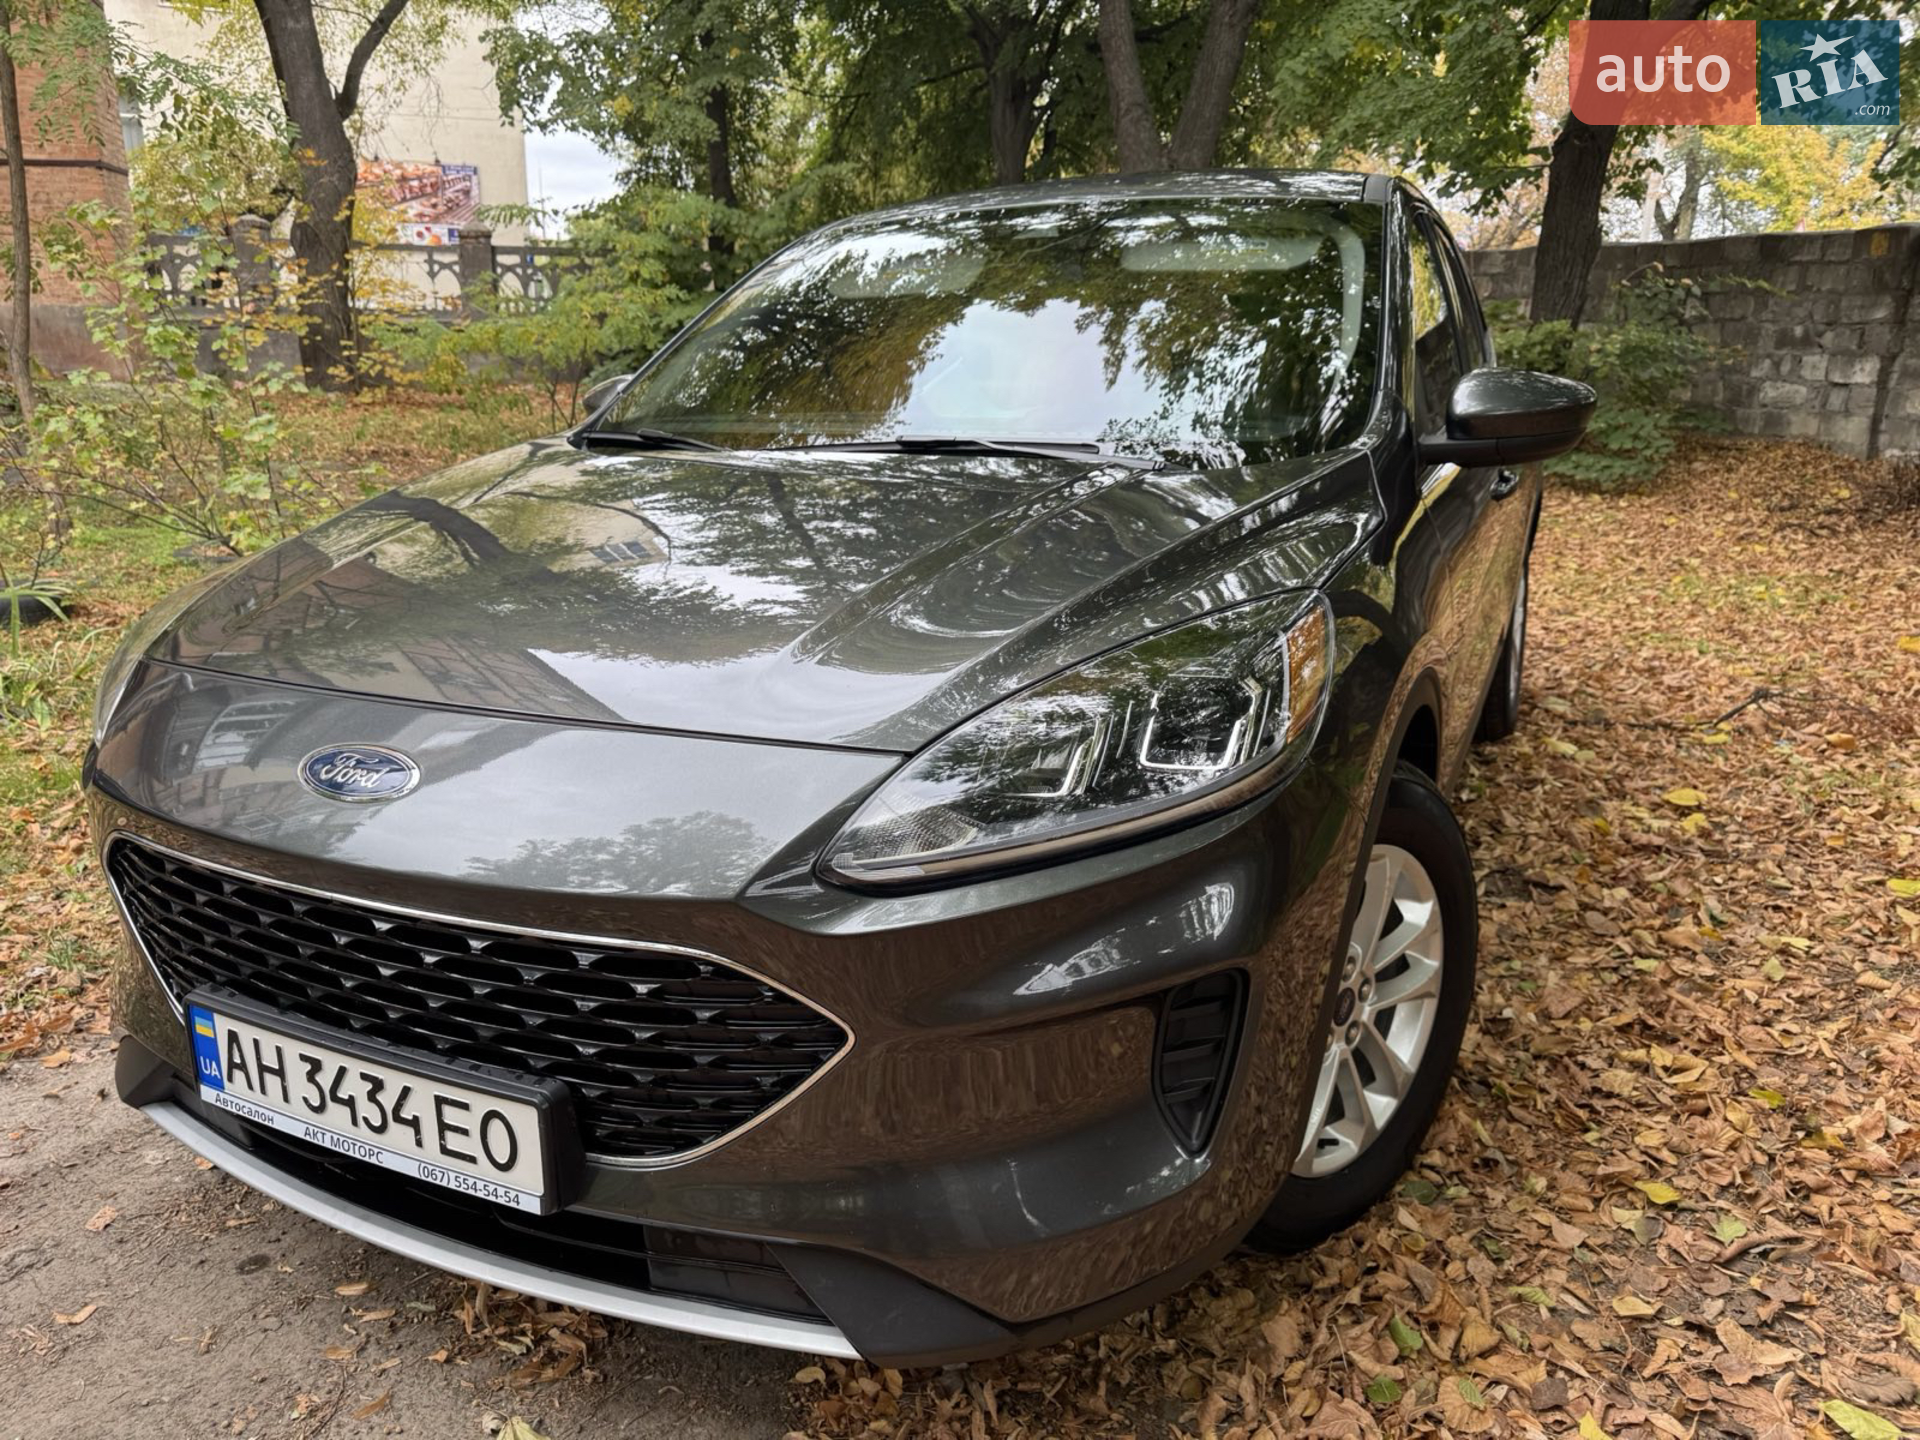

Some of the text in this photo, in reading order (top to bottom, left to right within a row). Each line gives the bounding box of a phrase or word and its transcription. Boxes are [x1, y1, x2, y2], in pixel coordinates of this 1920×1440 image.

[320, 752, 389, 788] Ford
[199, 1056, 221, 1080] UA
[215, 1093, 520, 1206] Автосалон АКТ МОТОРС (067) 554-54-54
